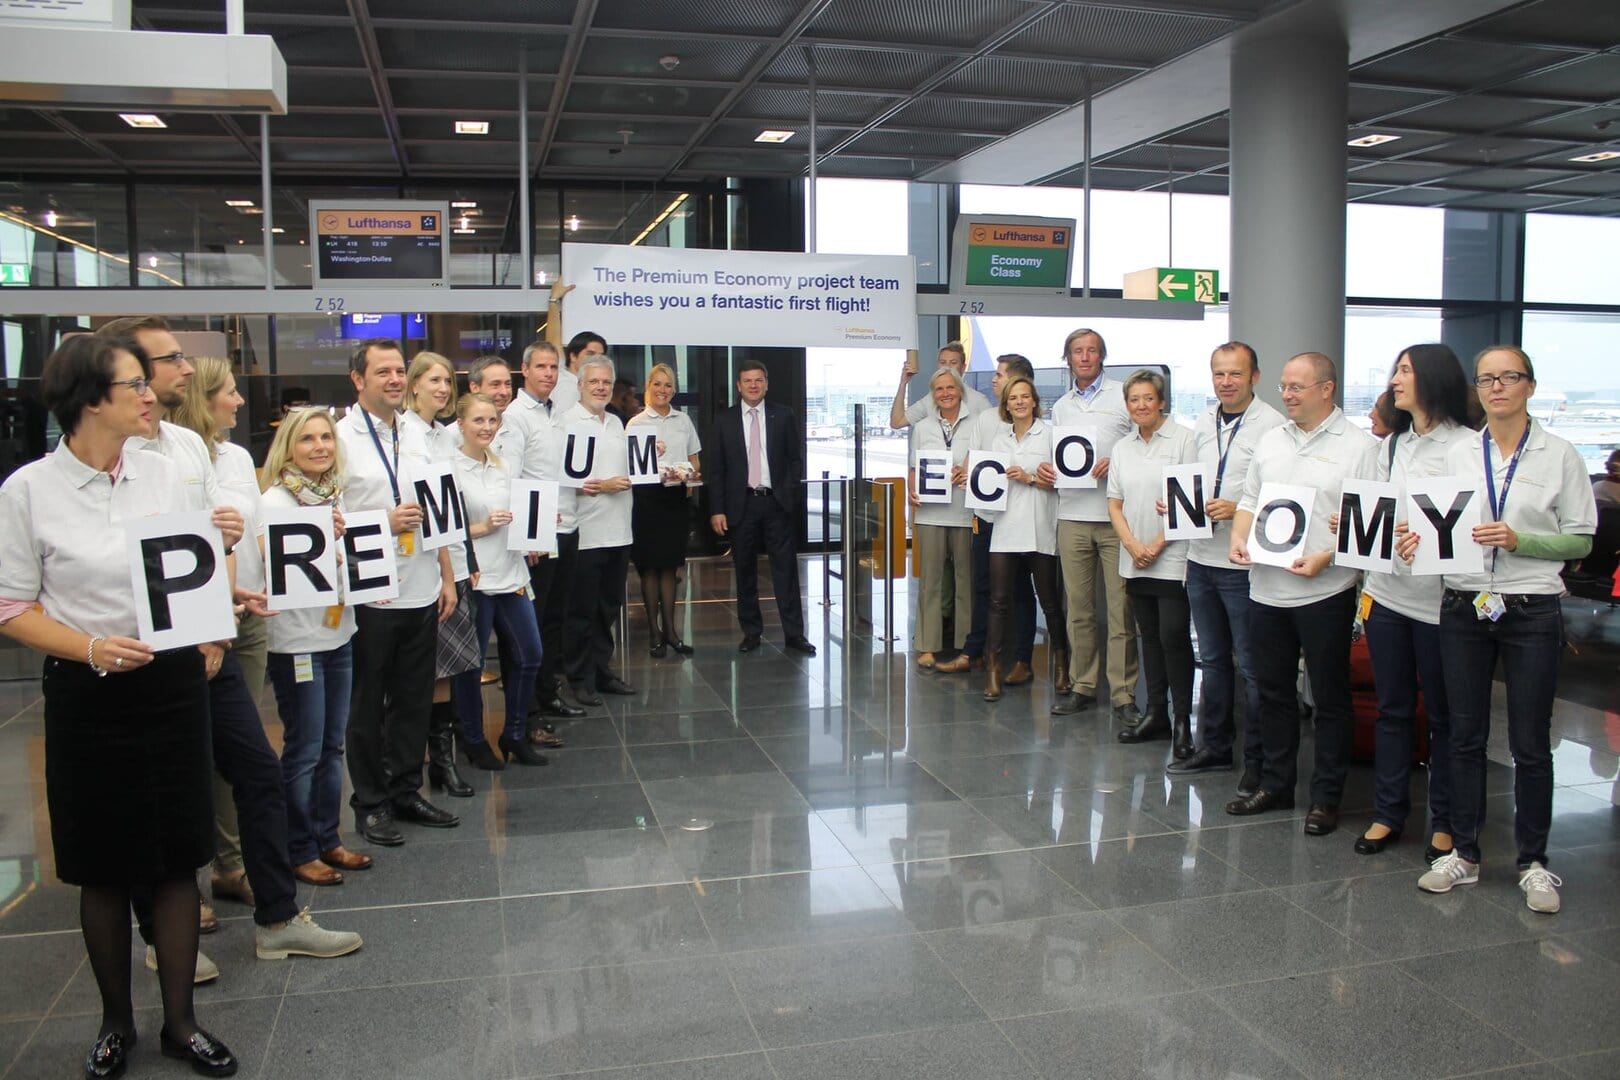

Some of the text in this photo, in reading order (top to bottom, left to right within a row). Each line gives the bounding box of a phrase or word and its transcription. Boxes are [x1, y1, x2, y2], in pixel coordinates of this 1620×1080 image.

[347, 217, 412, 229] Lufthansa
[993, 230, 1046, 242] Lufthansa
[593, 267, 900, 291] The Premium Economy project team
[990, 266, 1022, 278] Class
[991, 254, 1043, 268] Economy
[315, 298, 344, 311] Z 52
[593, 291, 871, 315] wishes you a fantastic first flight!
[960, 301, 985, 314] Z 52
[845, 333, 901, 342] Premium Economy
[564, 434, 595, 479] U
[628, 435, 659, 475] M
[1055, 435, 1095, 477] O
[919, 458, 947, 495] E
[969, 459, 1006, 502] C
[414, 473, 464, 539] M
[527, 490, 540, 540] I
[1166, 474, 1206, 530] N
[1255, 499, 1306, 553] O
[1340, 493, 1397, 560] M
[1412, 491, 1475, 560] Y
[268, 523, 334, 596] R
[343, 524, 391, 592] E
[141, 534, 216, 632] P
